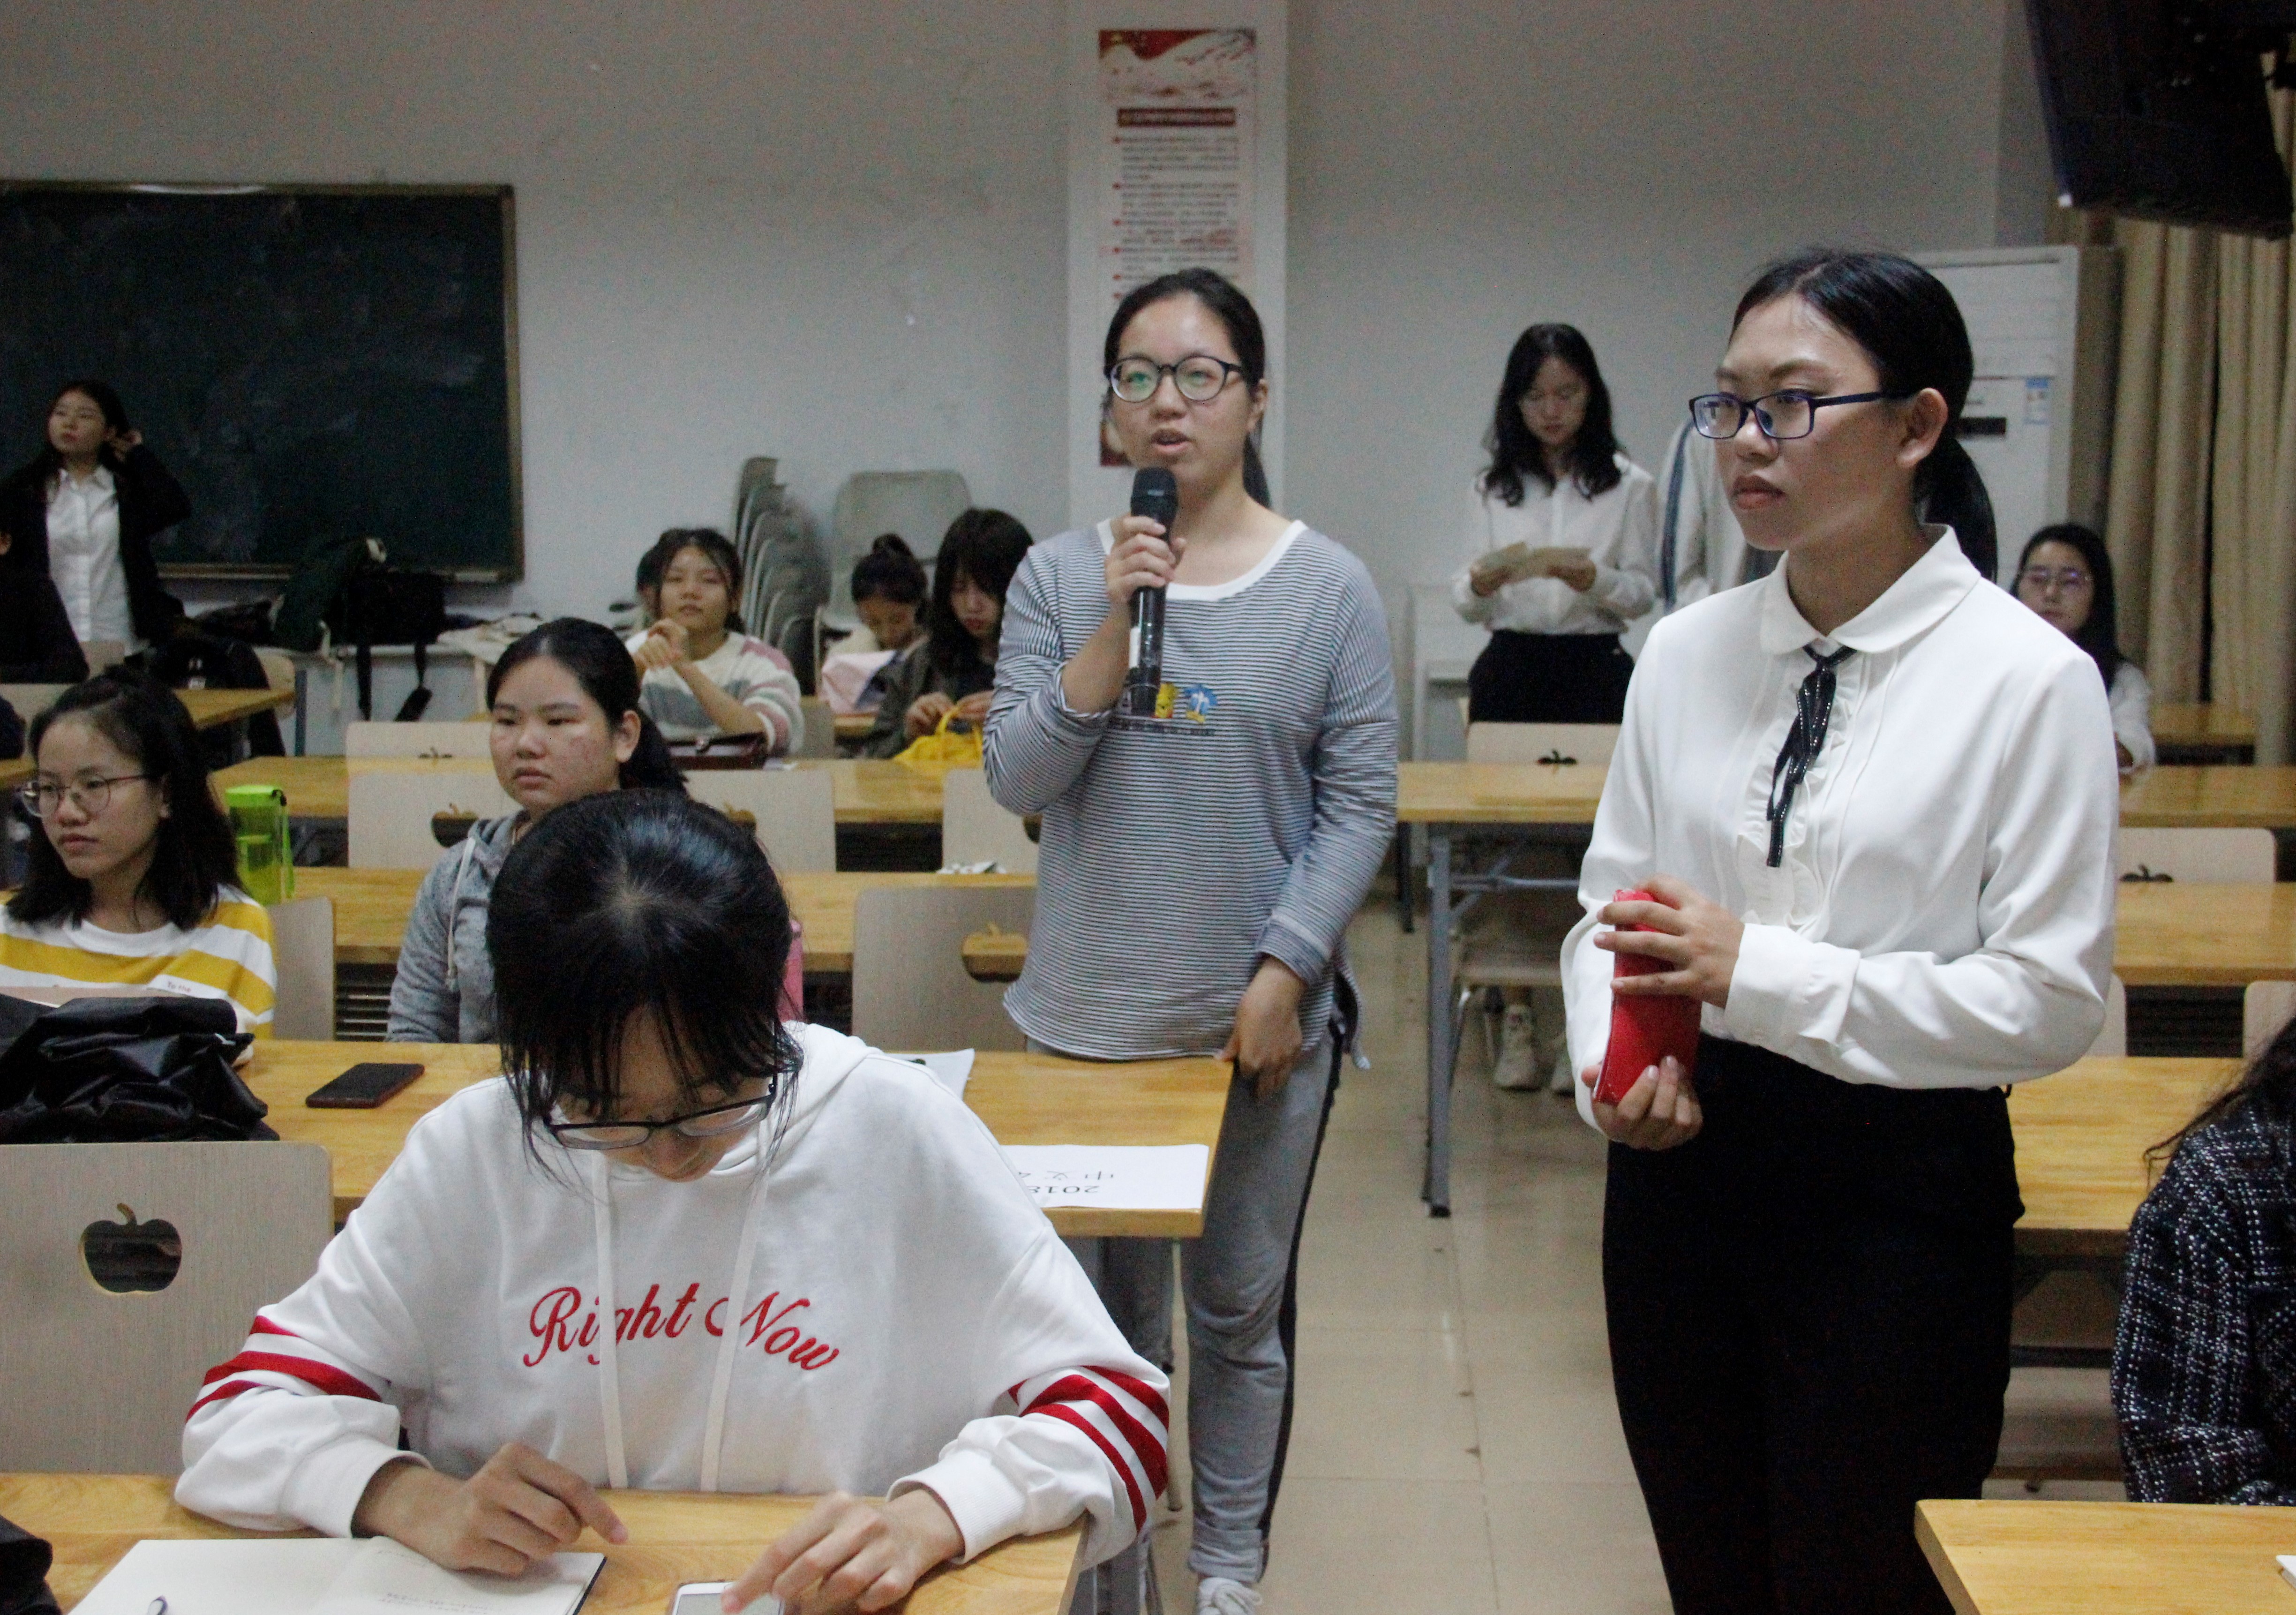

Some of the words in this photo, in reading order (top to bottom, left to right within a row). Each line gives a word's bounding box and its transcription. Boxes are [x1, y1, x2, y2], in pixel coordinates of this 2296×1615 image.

[1018, 1171, 1114, 1181] 中文
[1026, 1185, 1100, 1194] 2018
[523, 1282, 700, 1367] Right
[705, 1291, 840, 1371] Now
